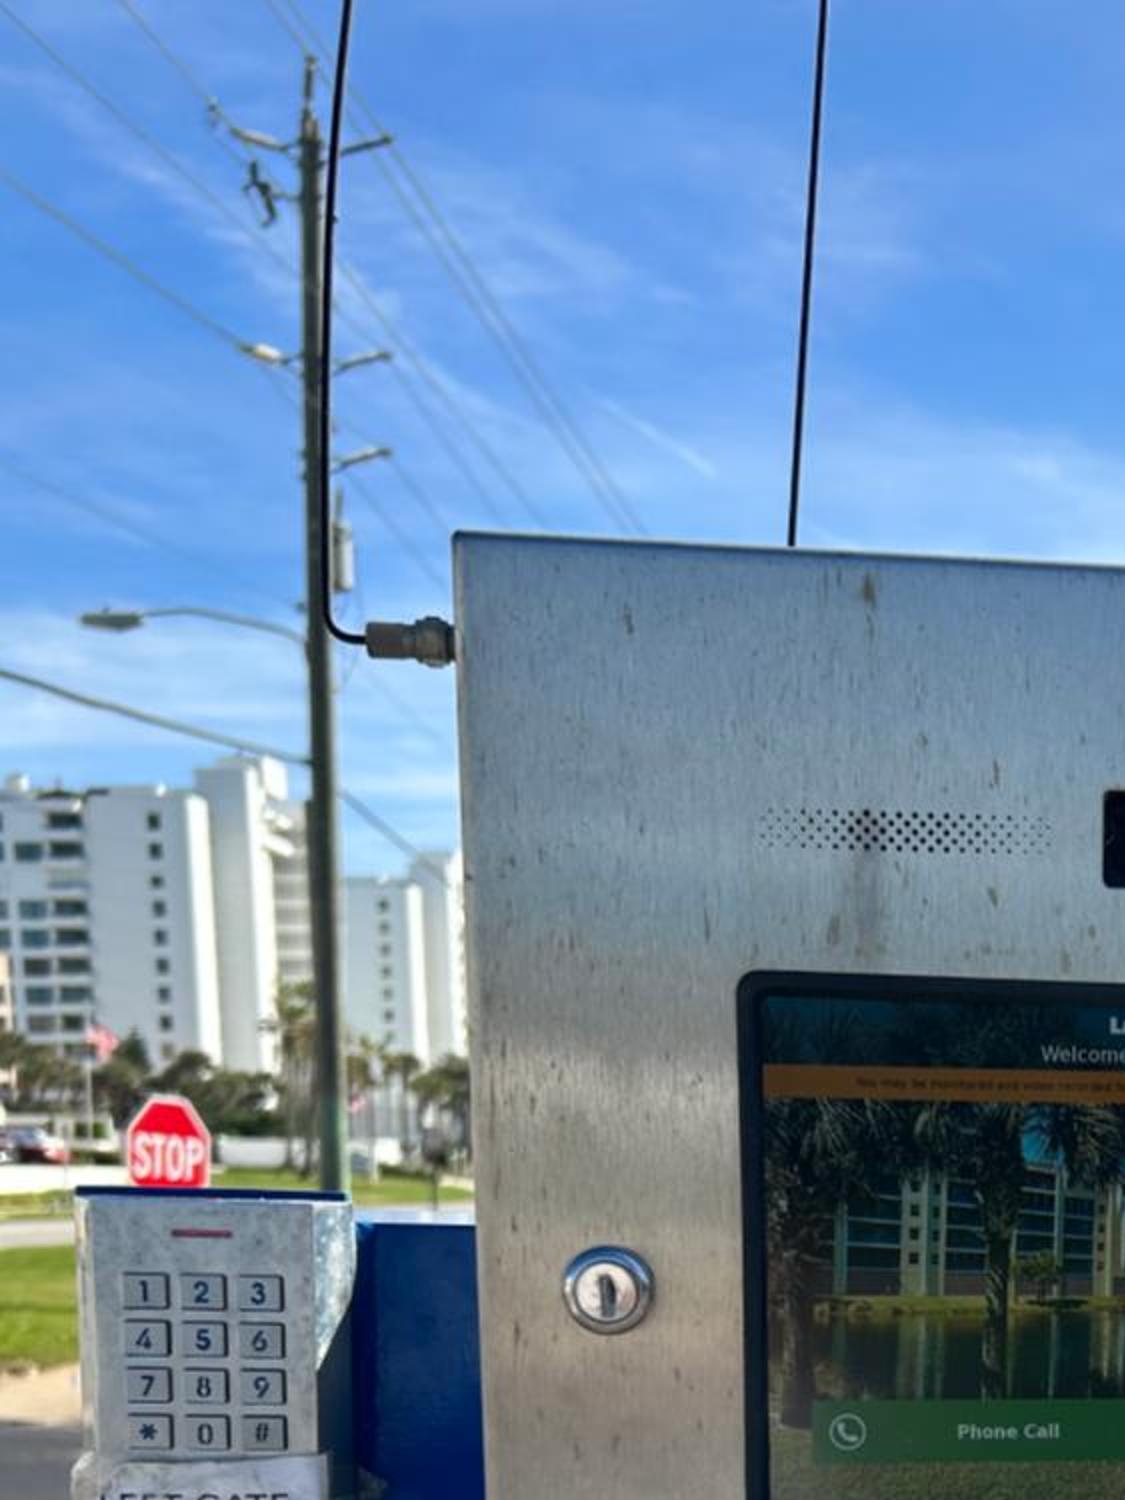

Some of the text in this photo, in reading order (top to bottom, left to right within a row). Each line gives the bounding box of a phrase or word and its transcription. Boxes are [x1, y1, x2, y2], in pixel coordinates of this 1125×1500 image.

[131, 1134, 201, 1182] STOP
[136, 1280, 267, 1305] 1 2 3
[135, 1328, 268, 1352] 4 5 6
[139, 1376, 270, 1399] 7 8 9
[198, 1423, 213, 1446] 0
[957, 1422, 1060, 1440] Phone Call
